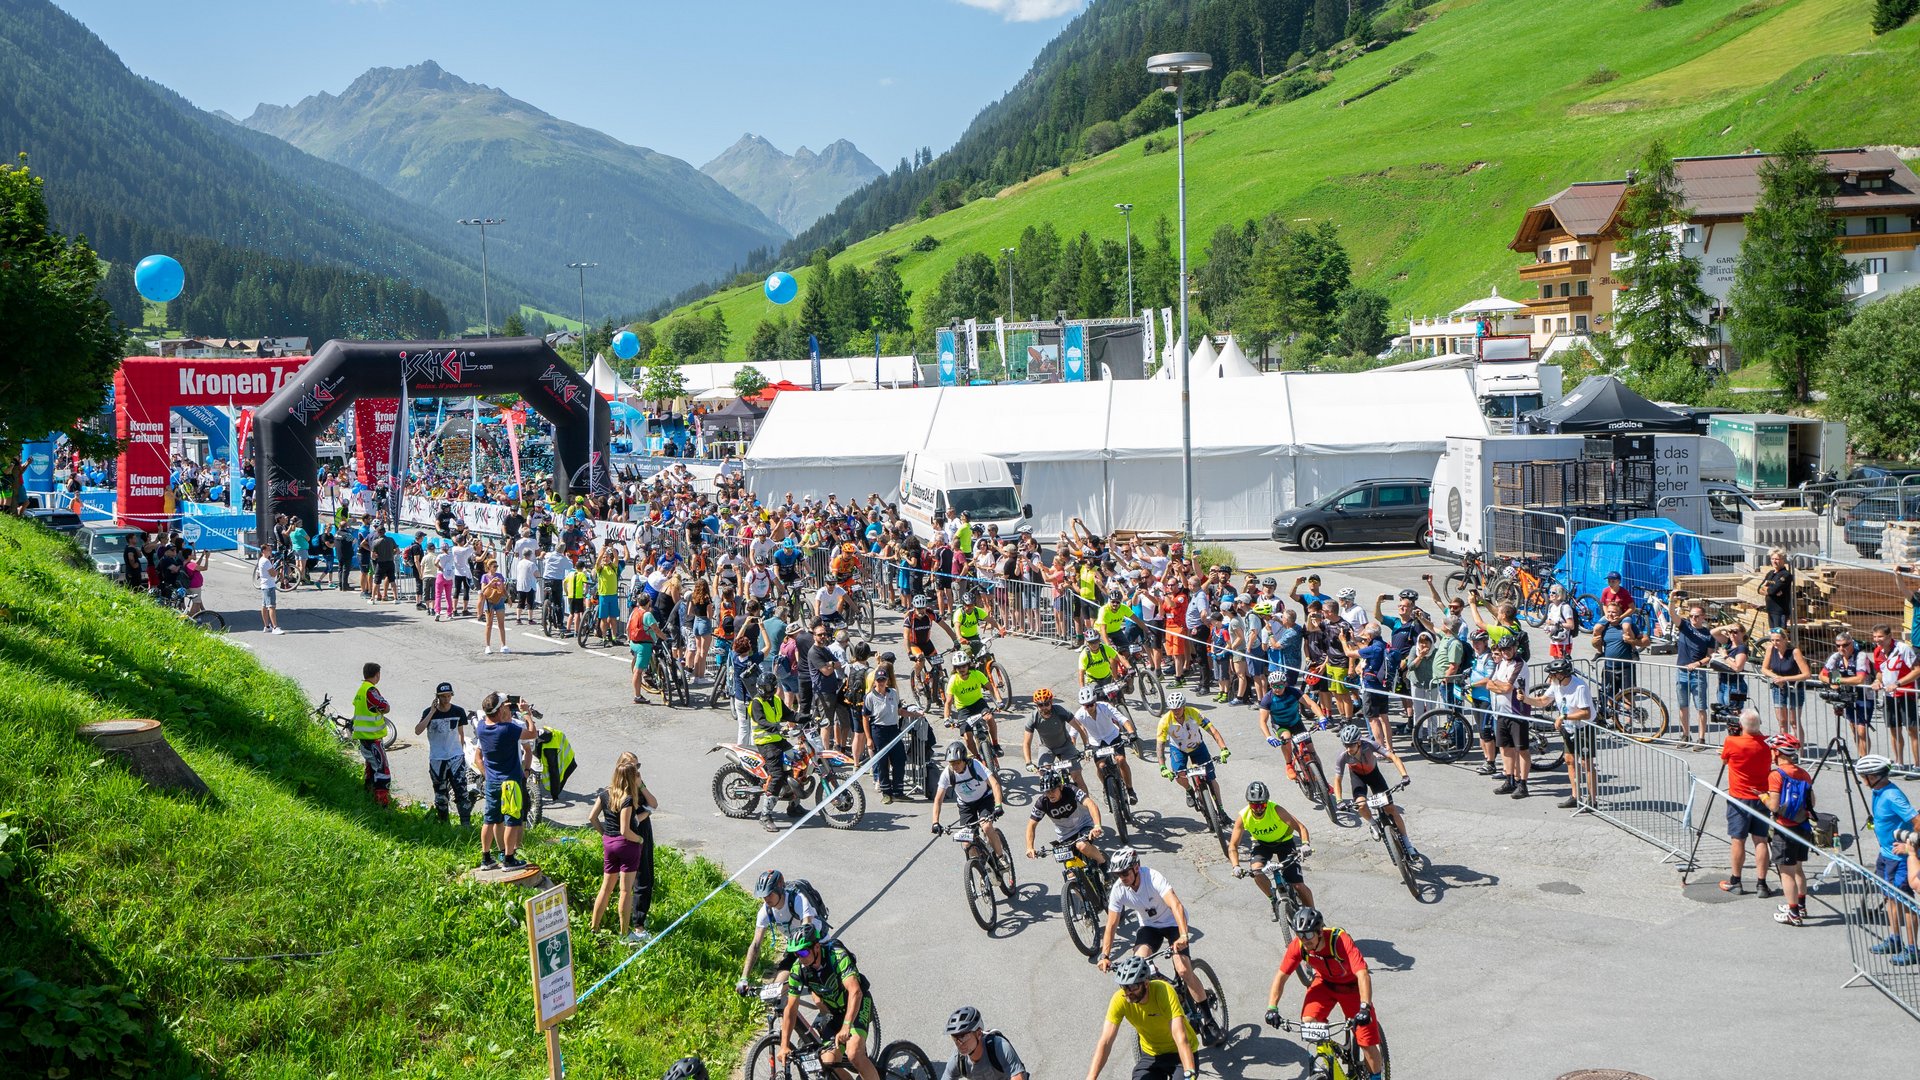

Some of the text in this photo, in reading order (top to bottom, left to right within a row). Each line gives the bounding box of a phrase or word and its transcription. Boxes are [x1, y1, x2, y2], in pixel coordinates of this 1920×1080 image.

[179, 367, 267, 395] Kronen
[130, 421, 164, 431] Kronen
[346, 409, 355, 442] Jeep
[130, 432, 164, 445] Zeitung
[1664, 445, 1689, 459] das
[1676, 461, 1688, 474] in
[130, 473, 164, 485] Kronen
[130, 485, 164, 497] Zeitung
